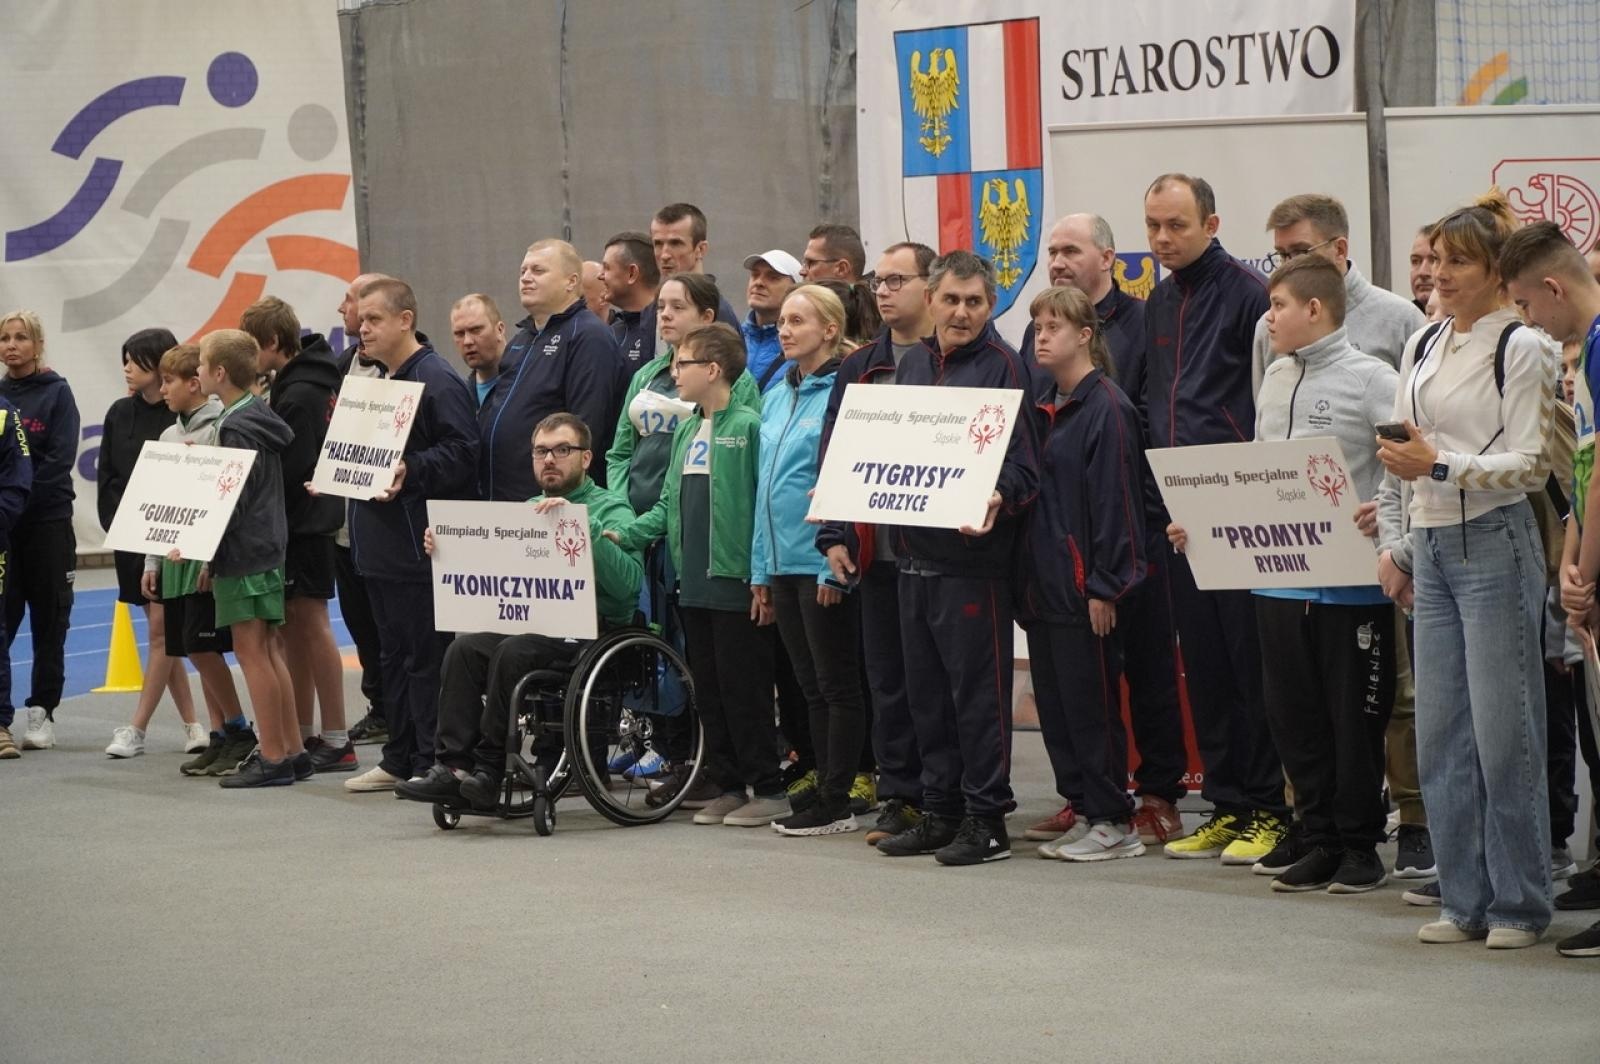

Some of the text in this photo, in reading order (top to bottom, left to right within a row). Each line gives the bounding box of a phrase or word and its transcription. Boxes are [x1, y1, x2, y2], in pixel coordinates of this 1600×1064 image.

[1061, 25, 1340, 100] STAROSTWO
[844, 409, 967, 426] Olimpiady Specjalne
[1164, 469, 1299, 489] Olimpiady Specjalne
[868, 492, 929, 512] GORZYCE
[145, 527, 180, 544] ZABRZE
[435, 524, 549, 541] Olimpiady Specjalne
[1254, 553, 1310, 573] RYBNIK
[498, 598, 530, 621] ŻORY
